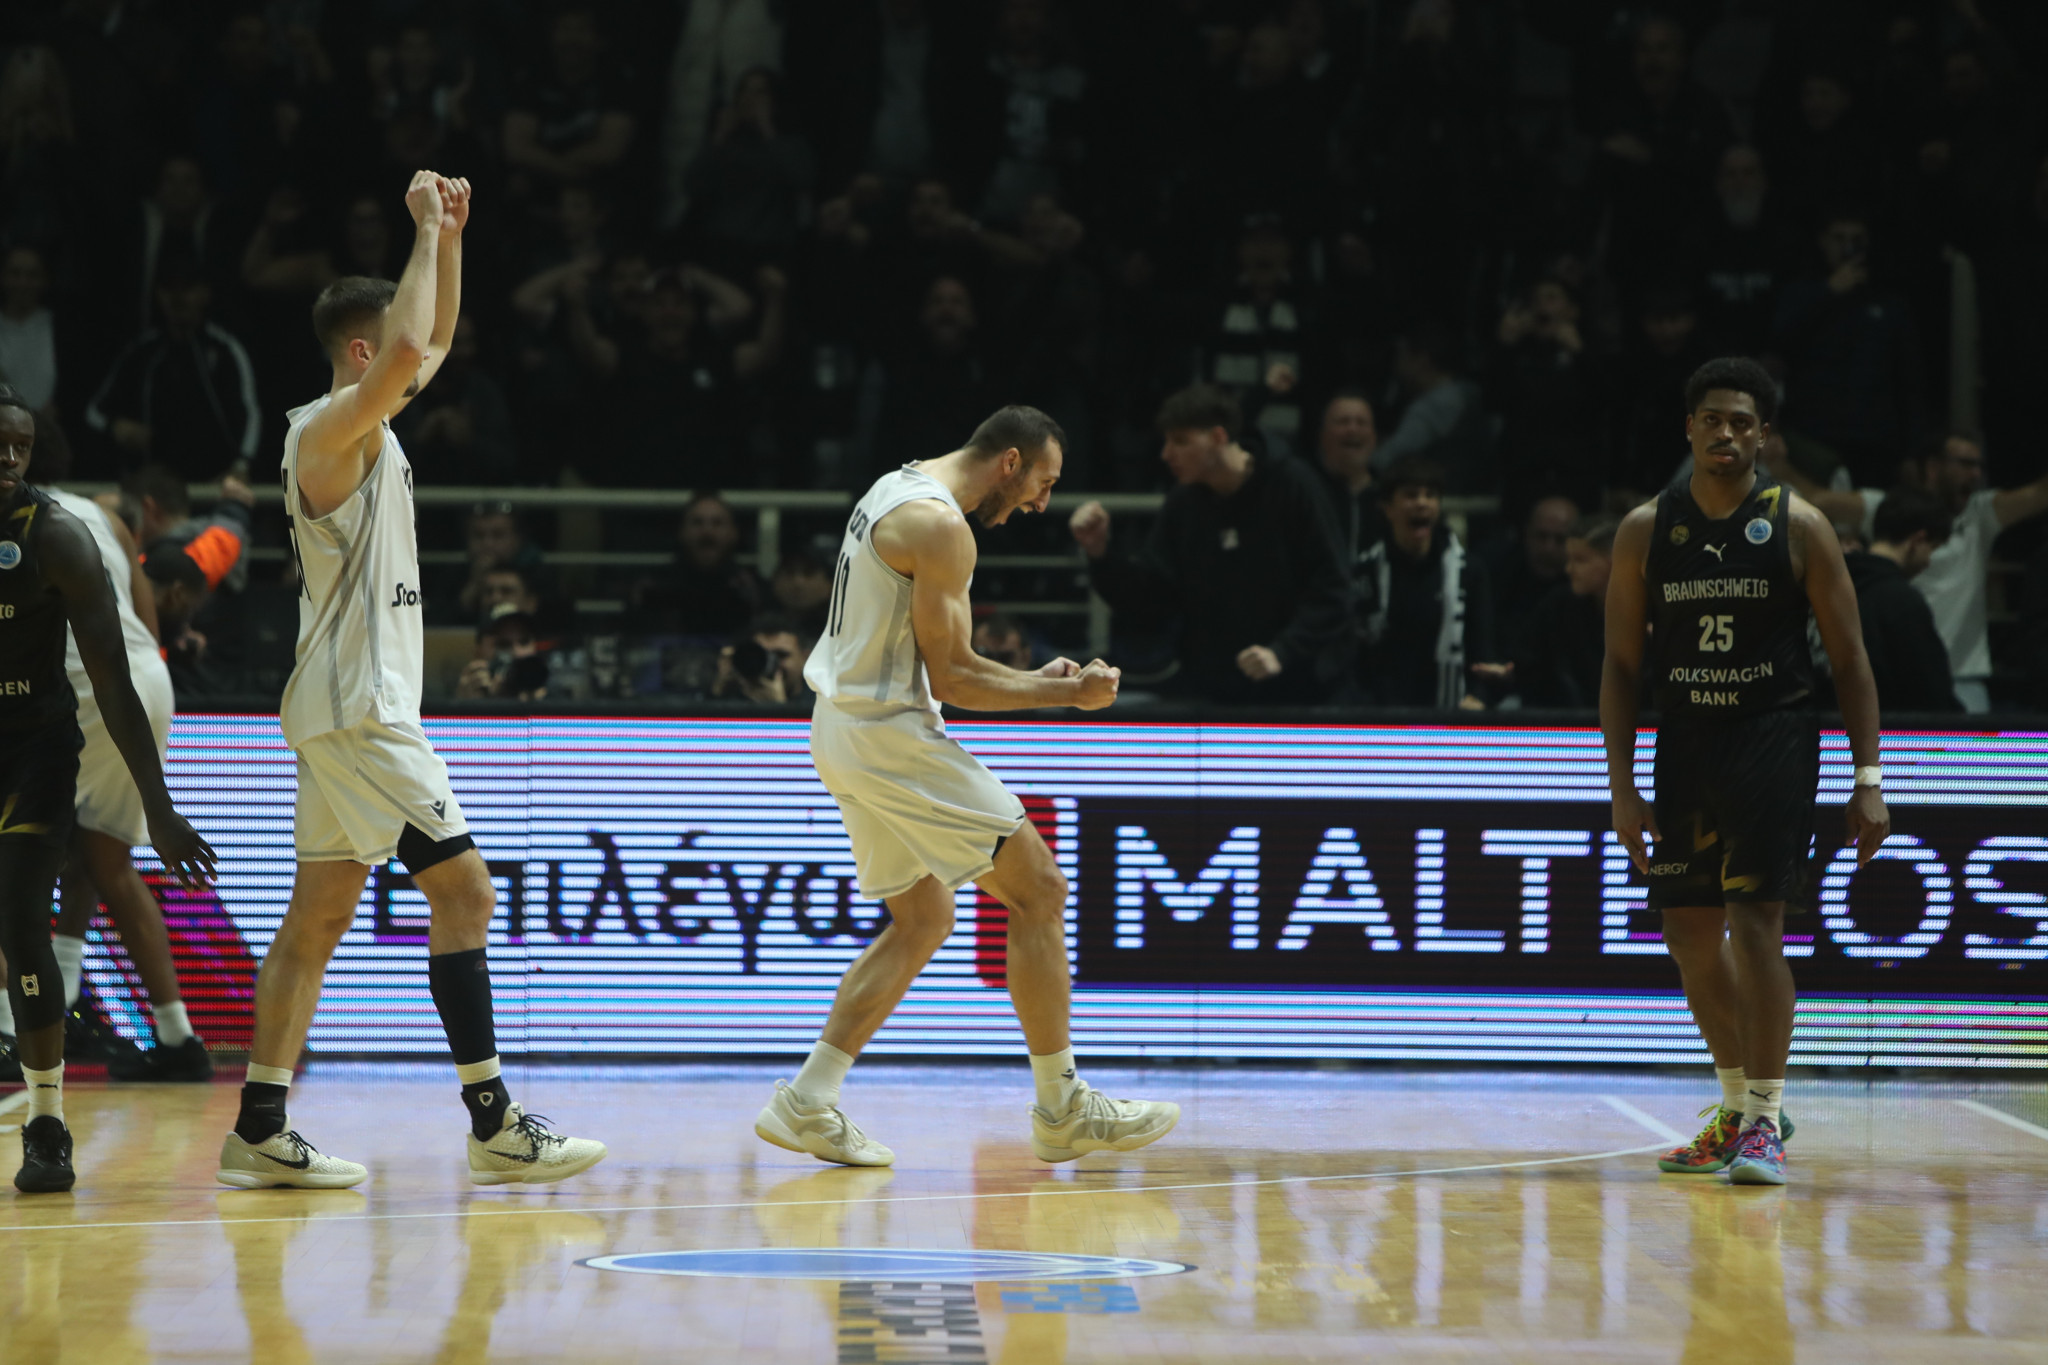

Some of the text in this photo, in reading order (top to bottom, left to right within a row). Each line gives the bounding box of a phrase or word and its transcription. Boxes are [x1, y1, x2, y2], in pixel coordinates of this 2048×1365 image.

[1663, 577, 1769, 603] BRAUNSCHWEIG
[1699, 614, 1734, 652] 25
[1690, 689, 1740, 706] BANK
[1649, 862, 1689, 876] NERGY
[1115, 825, 2048, 961] MALTEOS
